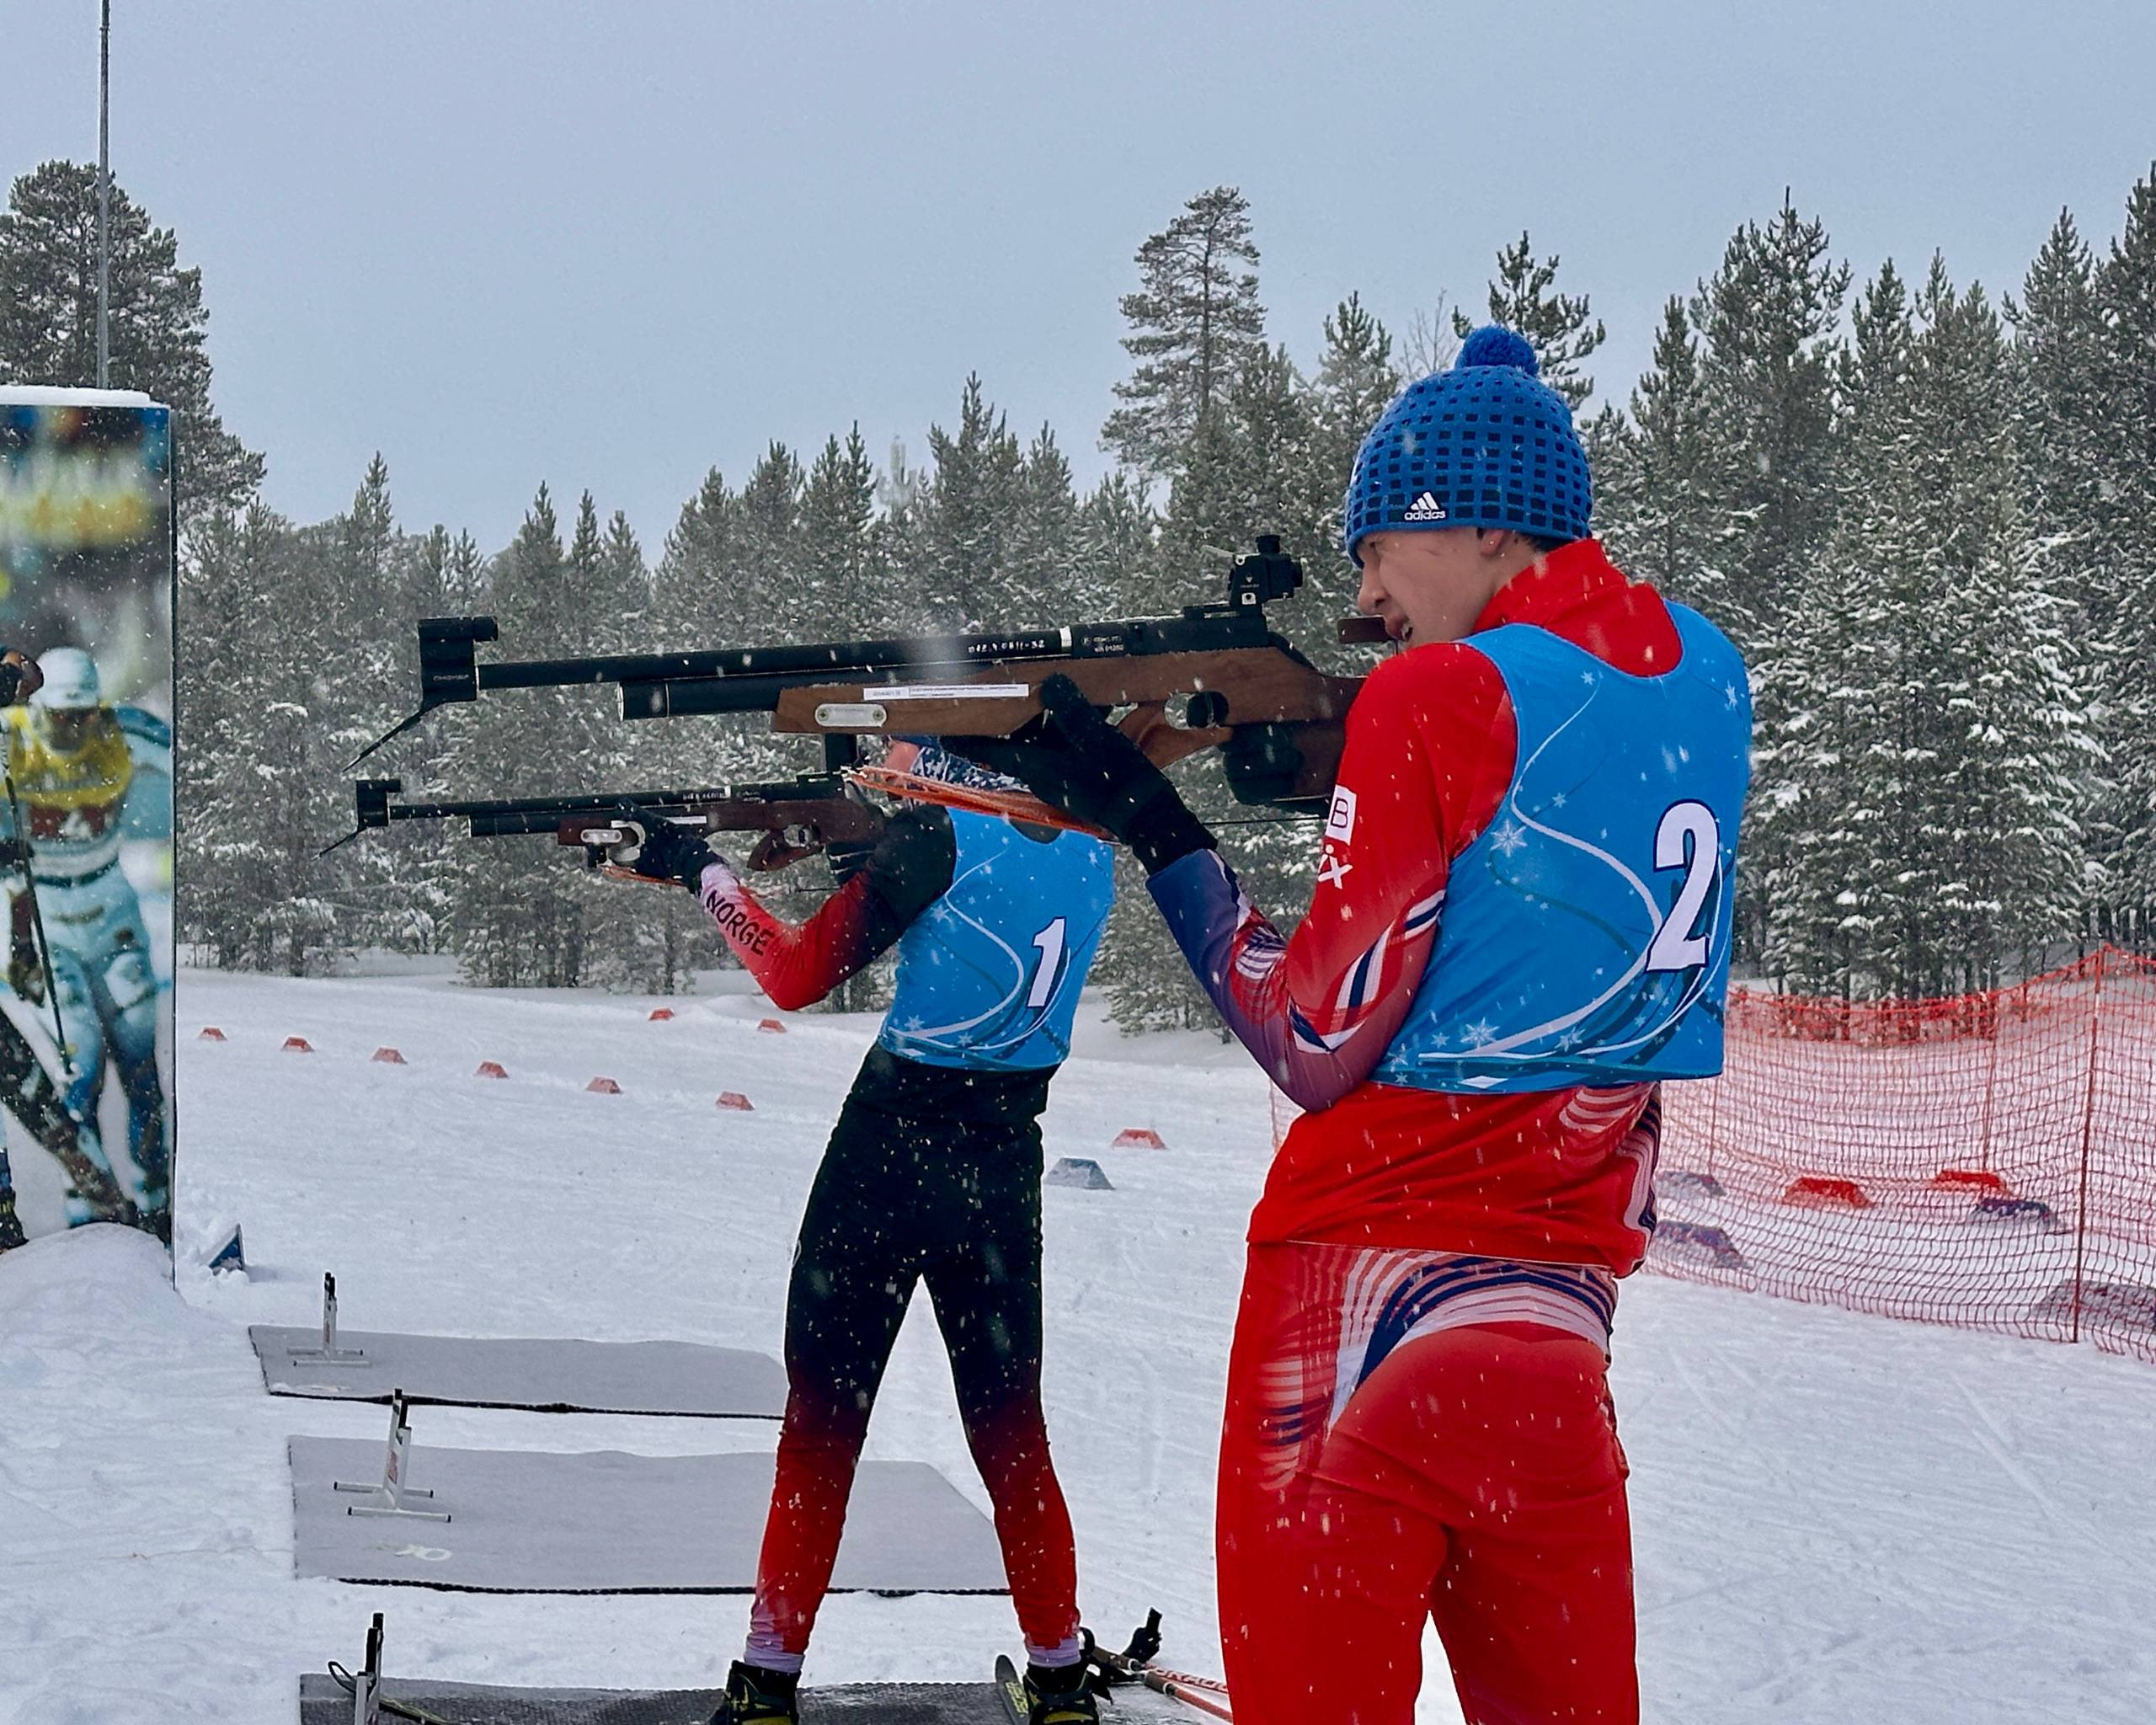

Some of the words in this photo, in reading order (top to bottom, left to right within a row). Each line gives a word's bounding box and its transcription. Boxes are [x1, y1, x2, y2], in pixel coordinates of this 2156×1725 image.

[1404, 510, 1446, 521] adidas
[706, 889, 775, 957] NORGE
[1644, 798, 1721, 973] 2
[1027, 916, 1067, 1009] 1
